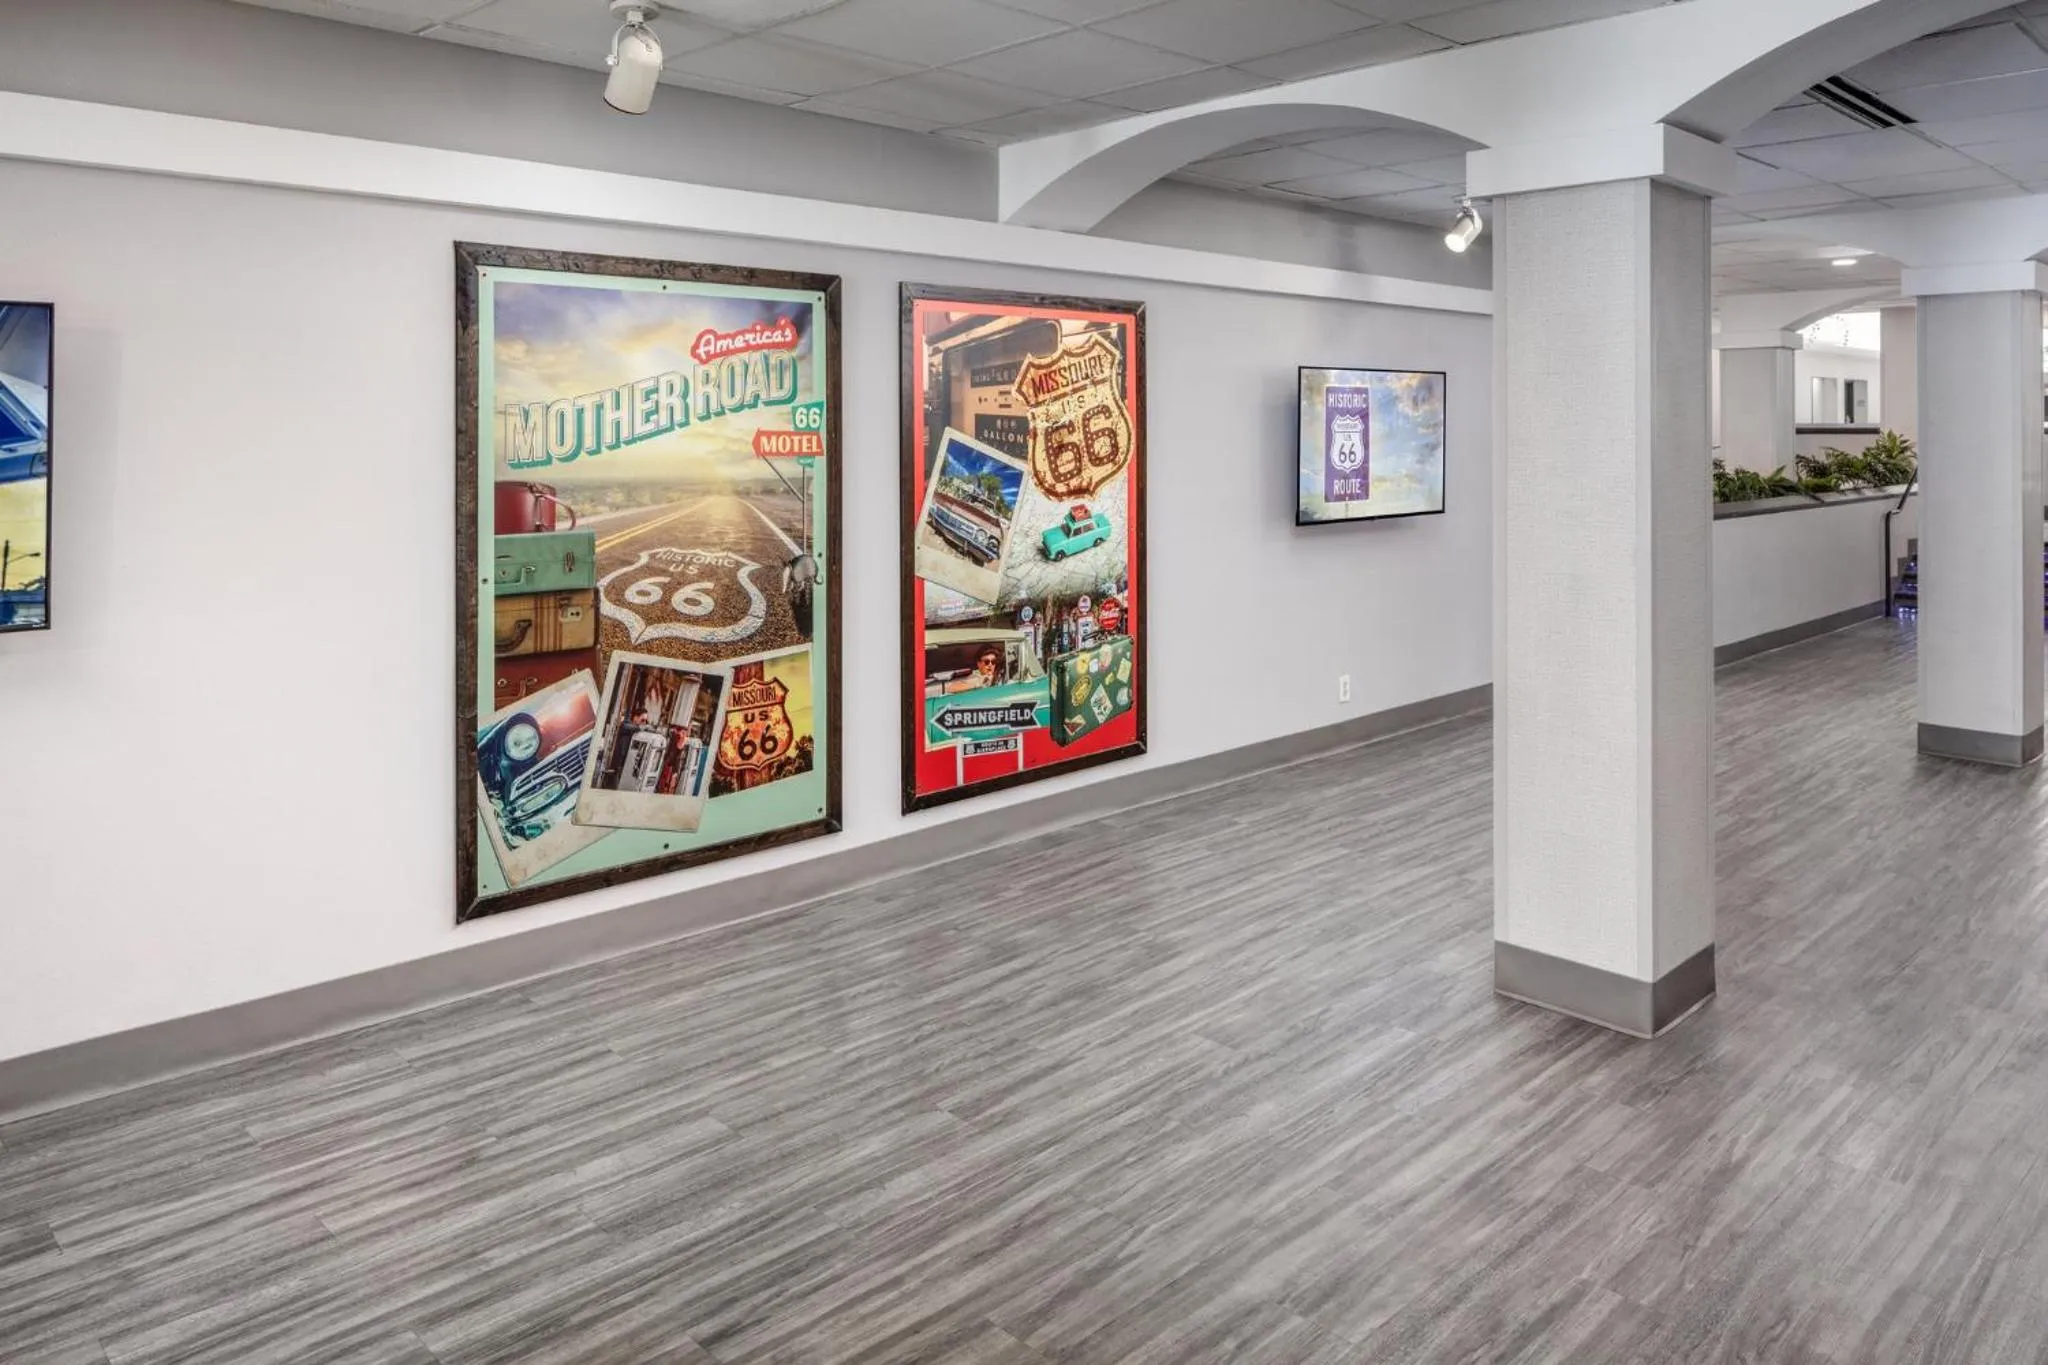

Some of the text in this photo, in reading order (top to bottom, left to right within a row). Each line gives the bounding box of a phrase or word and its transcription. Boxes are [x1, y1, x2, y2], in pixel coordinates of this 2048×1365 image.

[695, 318, 793, 360] America's
[1031, 354, 1109, 398] MISSOURI
[504, 350, 798, 470] MOTHER ROAD
[1328, 393, 1367, 408] HISTORIC
[795, 407, 821, 428] 66
[760, 434, 821, 453] MOTEL
[1044, 404, 1119, 484] 66
[1338, 442, 1357, 464] 66
[1333, 478, 1361, 495] ROUTE
[655, 550, 737, 568] HISTORIC
[668, 563, 699, 575] US
[624, 576, 716, 616] 66
[732, 684, 776, 708] MISSOURI
[743, 710, 769, 723] US
[944, 708, 1033, 727] SPRINGFIELD
[738, 724, 779, 760] 66
